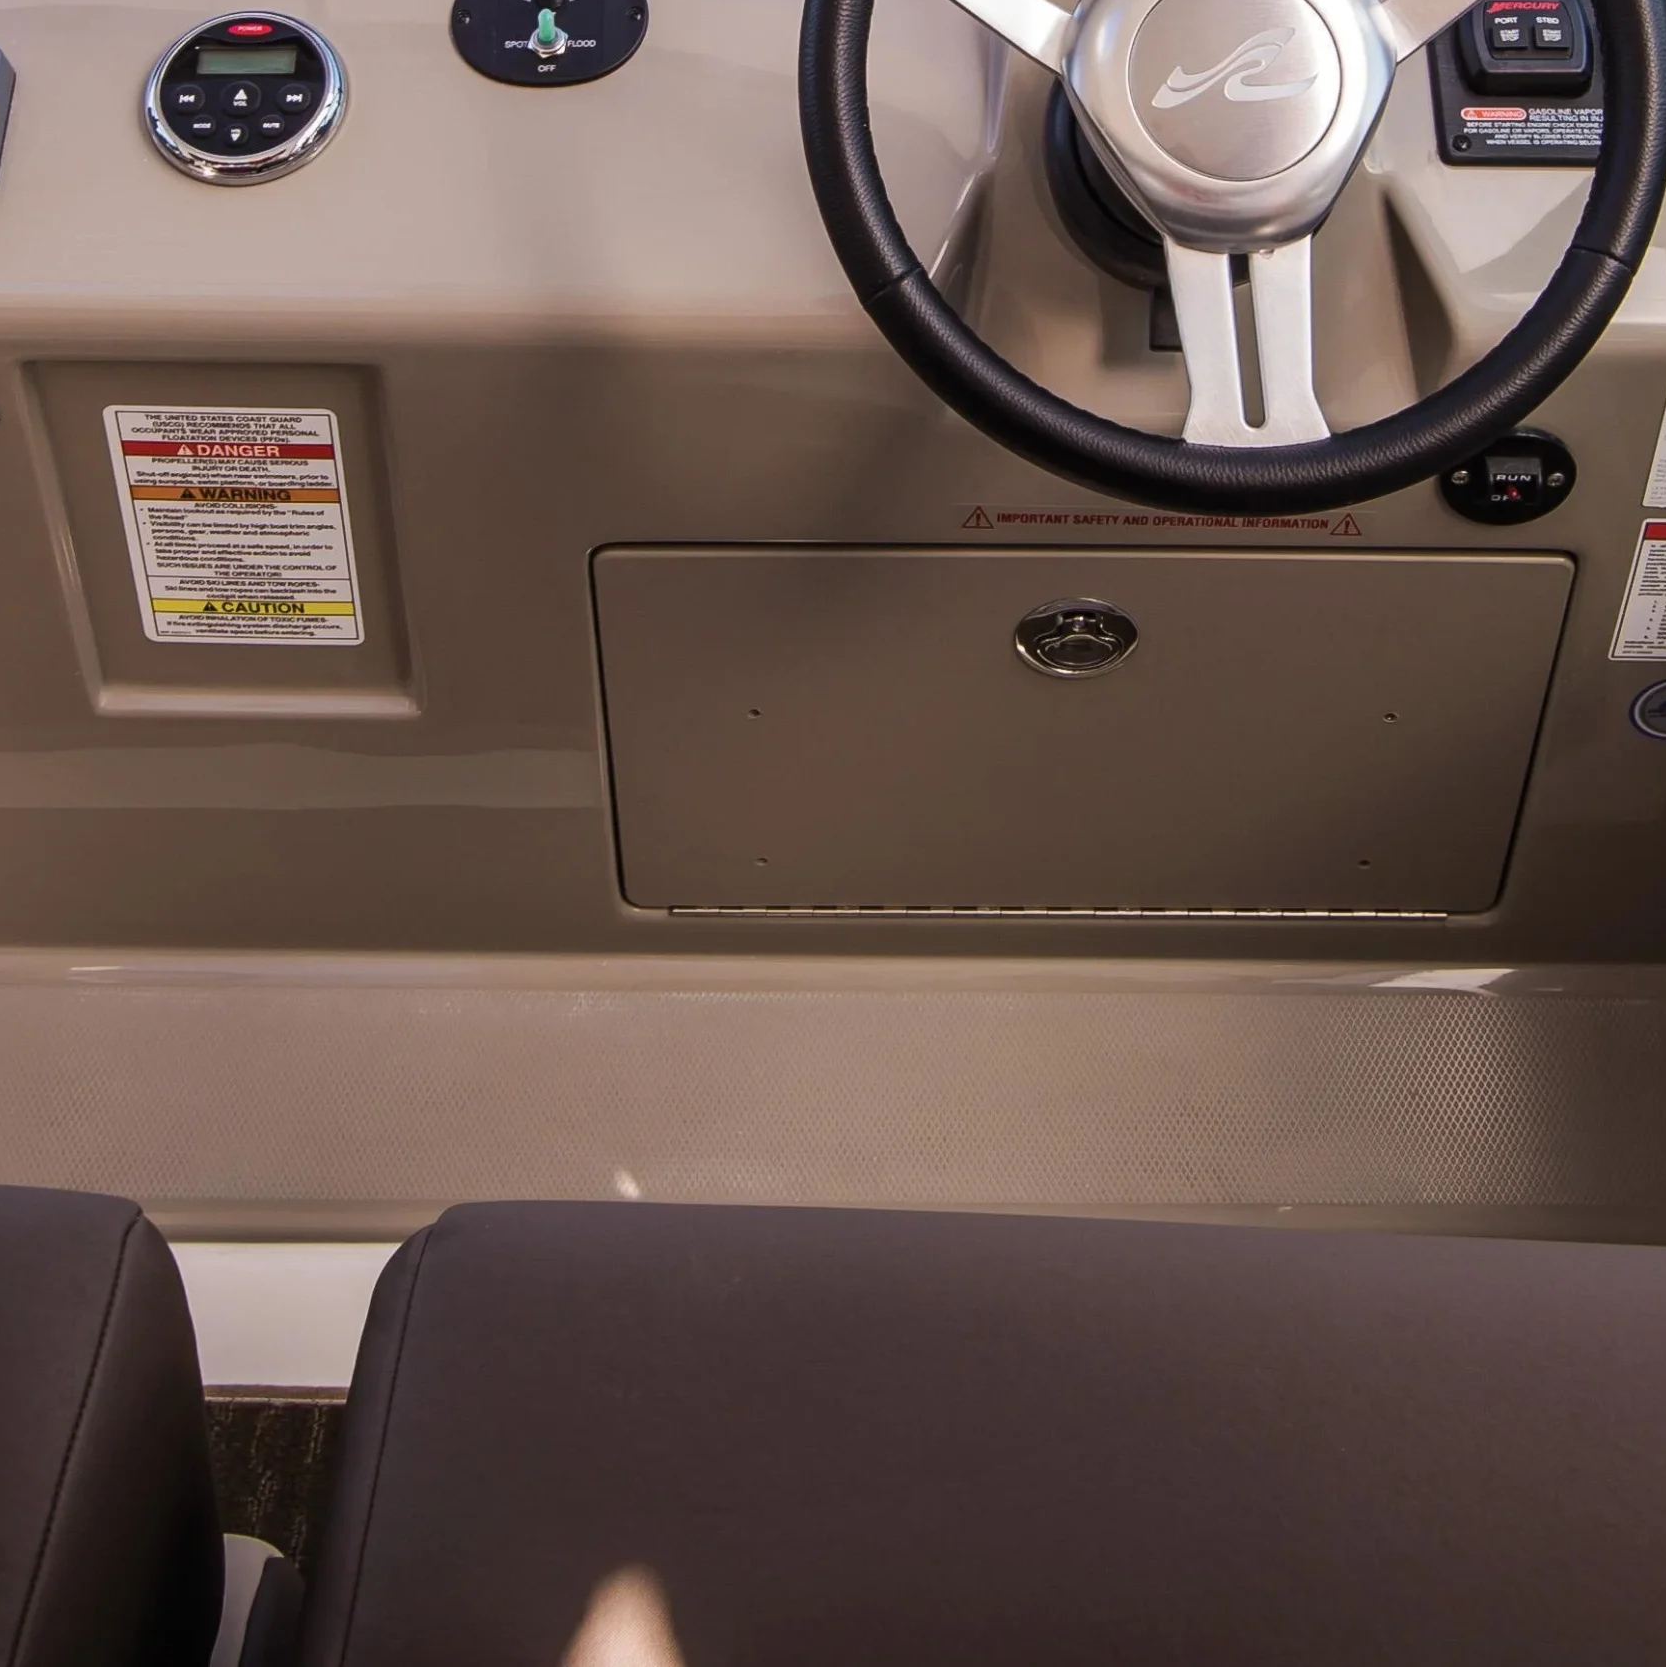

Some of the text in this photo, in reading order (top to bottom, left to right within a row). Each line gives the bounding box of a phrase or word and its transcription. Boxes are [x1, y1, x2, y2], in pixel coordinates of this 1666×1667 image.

[1487, 2, 1559, 13] MERCURY
[197, 445, 280, 457] DANGER
[200, 488, 291, 501] WARNING
[997, 513, 1329, 530] IMPORTANT SAFETY AND OPERATIONAL INFORMATION
[221, 603, 305, 614] CAUTION
